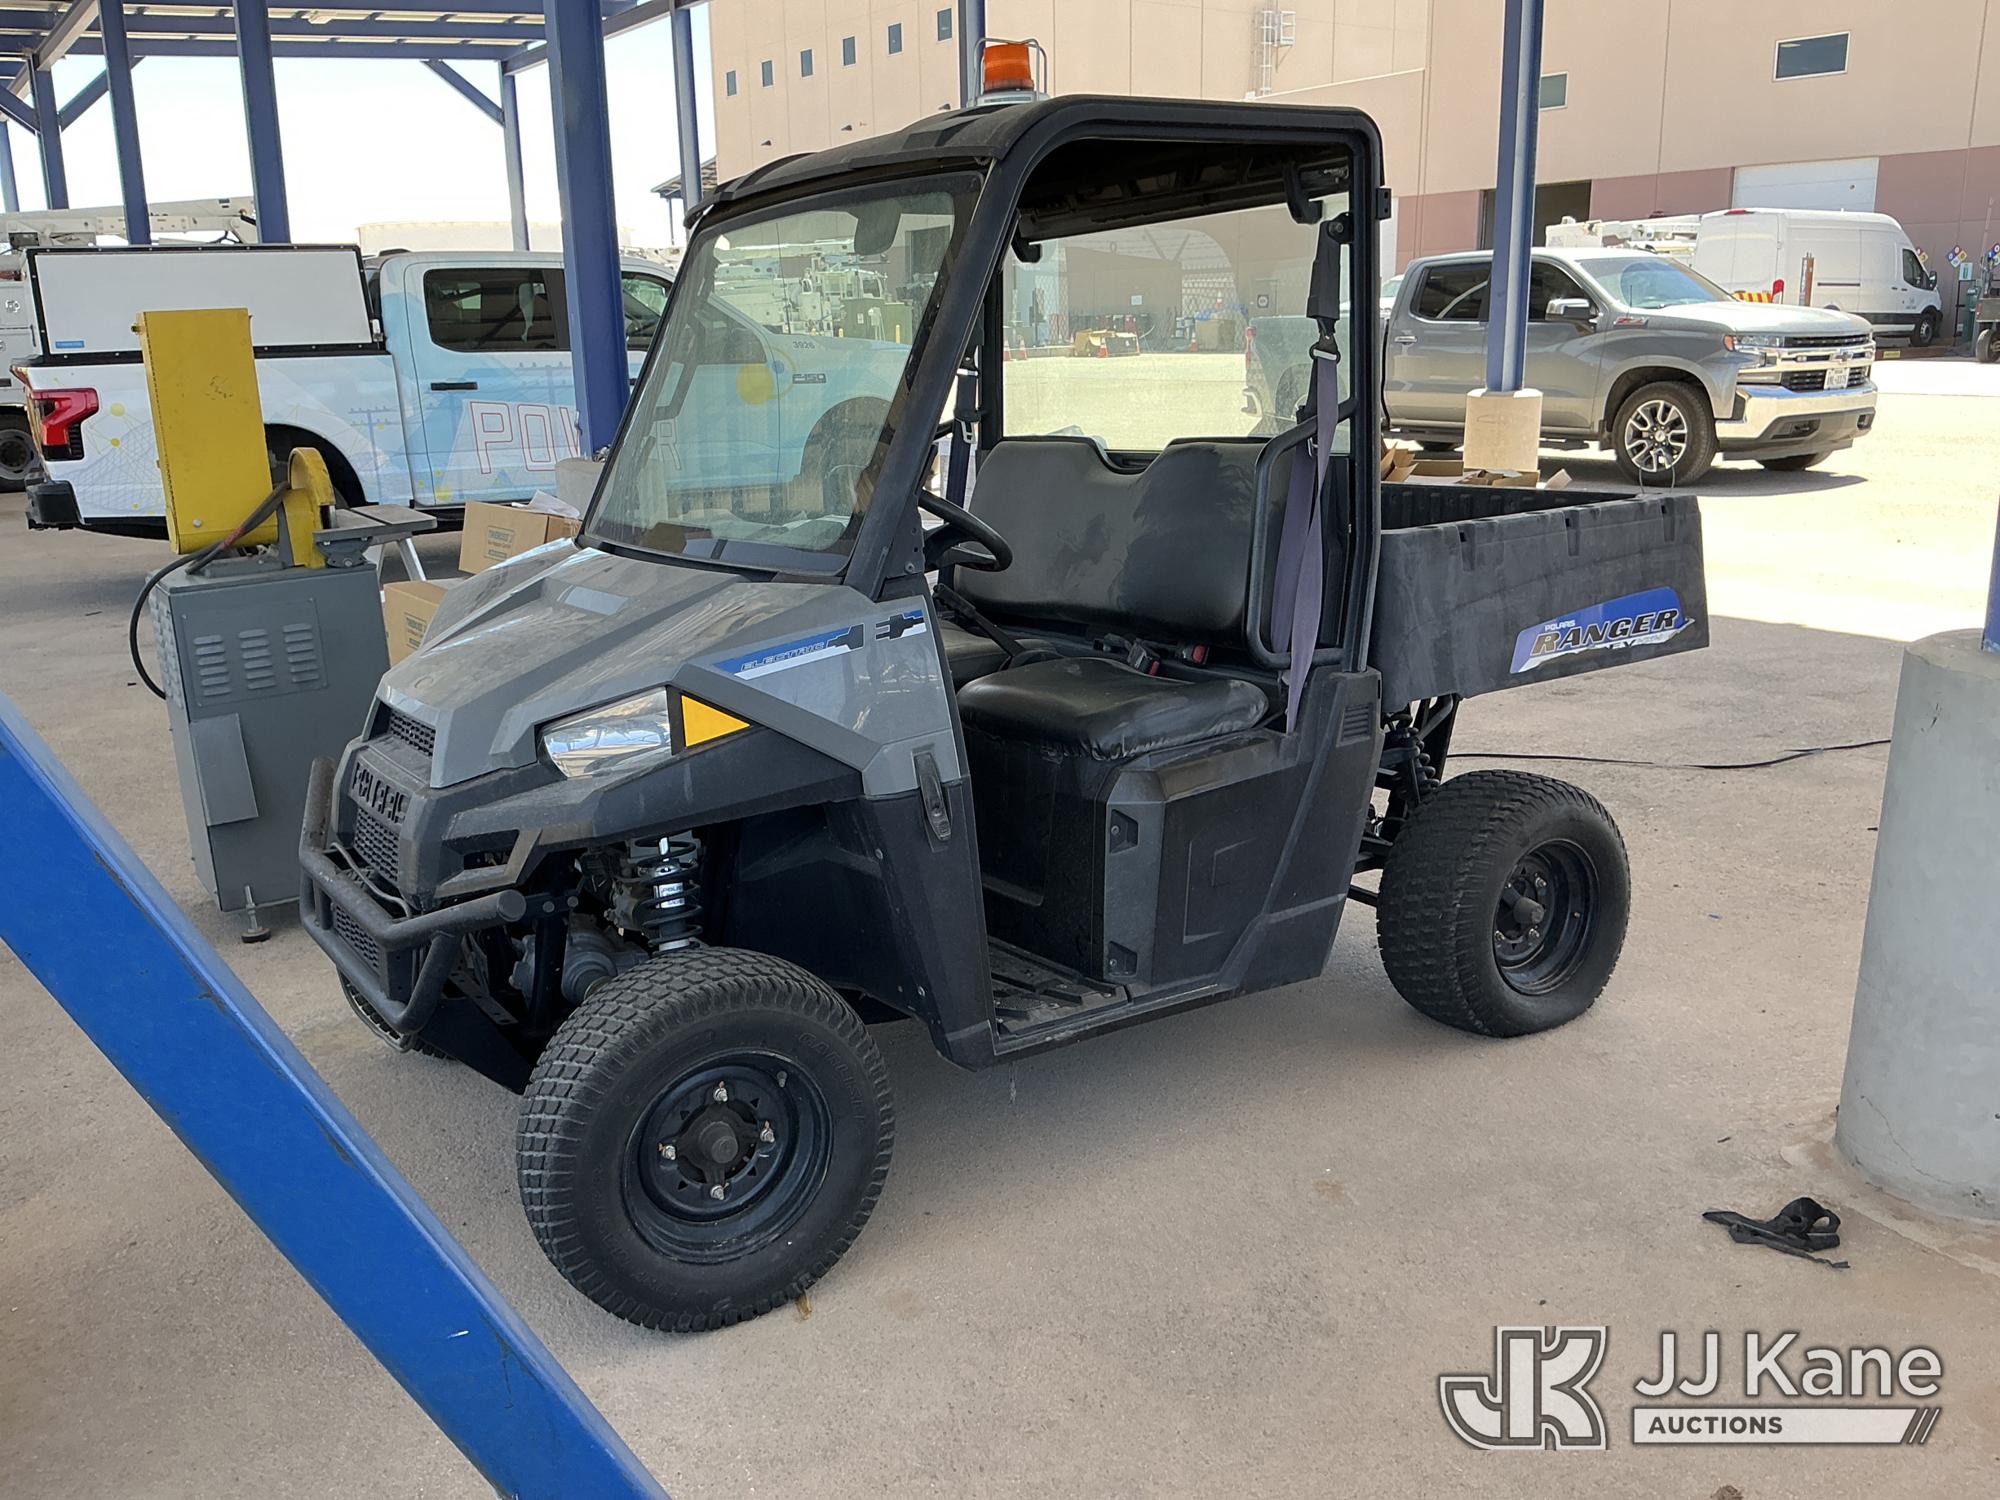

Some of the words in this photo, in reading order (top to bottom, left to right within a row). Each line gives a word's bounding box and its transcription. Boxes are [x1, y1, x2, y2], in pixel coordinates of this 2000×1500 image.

[1530, 608, 1680, 656] RANGER
[1544, 619, 1576, 632] POLARIS
[740, 641, 825, 671] ELECTRIC
[352, 762, 409, 824] POLARIS
